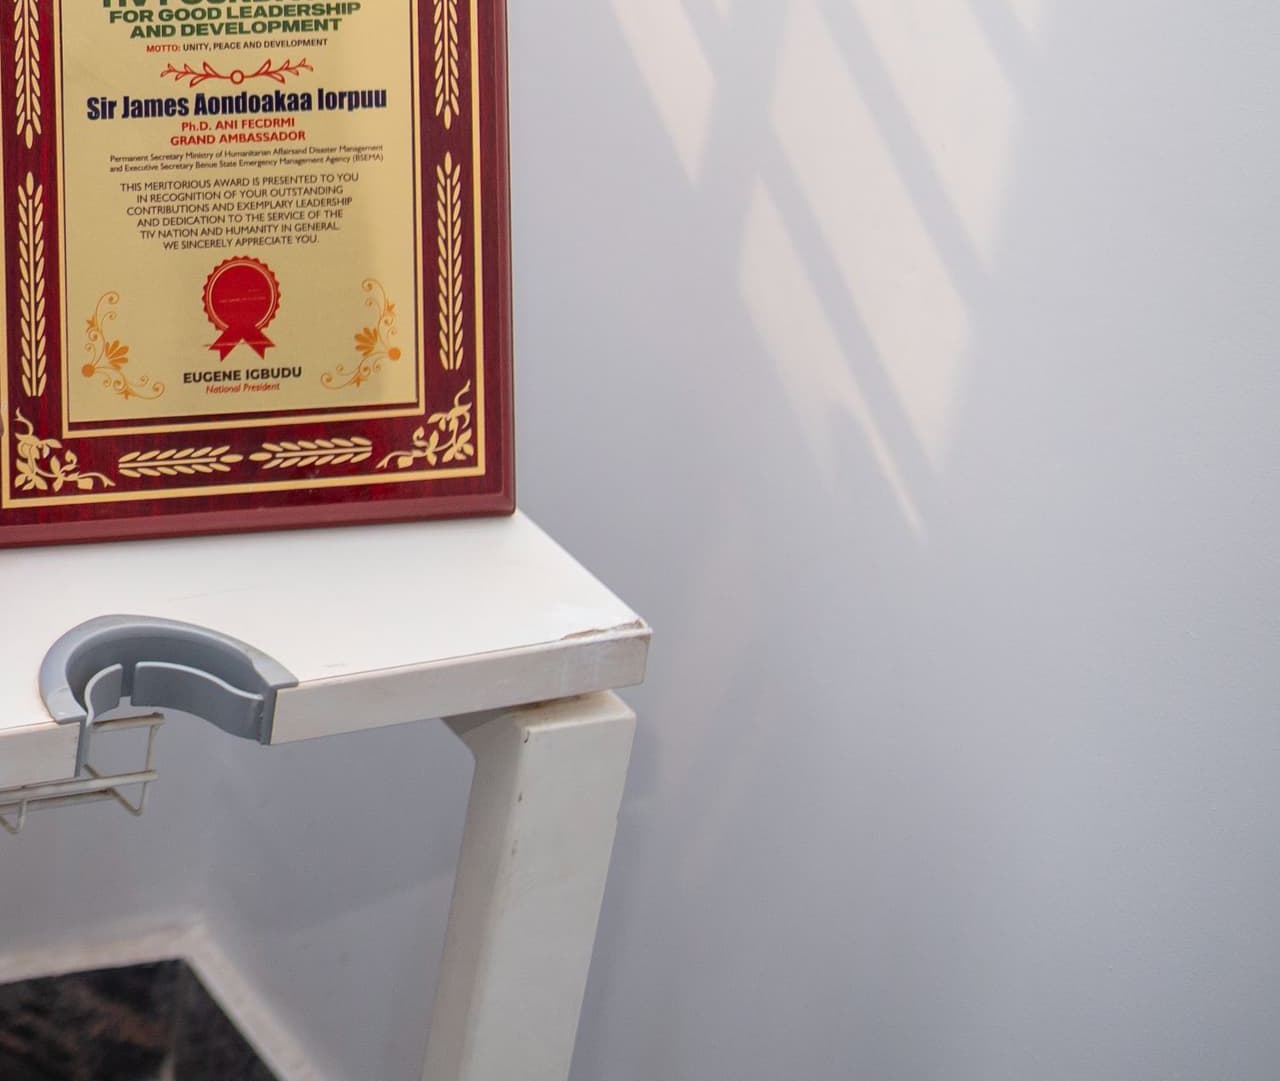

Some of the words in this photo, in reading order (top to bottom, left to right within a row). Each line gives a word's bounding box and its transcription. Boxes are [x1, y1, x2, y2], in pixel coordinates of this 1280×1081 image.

[109, 8, 153, 23] FOR
[158, 6, 222, 22] GOOD
[226, 2, 361, 20] LEADERSHIP
[130, 23, 176, 39] AND
[181, 18, 343, 37] DEVELOPMENT
[146, 44, 181, 53] MOTTO:
[182, 42, 212, 52] UNITY,
[213, 41, 241, 51] PEACE
[242, 40, 262, 49] AND
[263, 38, 328, 48] DEVELOPMENT
[87, 97, 117, 120] Sir
[121, 94, 189, 119] James
[193, 90, 313, 116] Aondoakaa
[317, 88, 387, 112] Iorpuu
[181, 121, 212, 133] Ph.D.
[214, 120, 238, 131] ANI
[241, 117, 296, 130] FECDRMI
[170, 134, 216, 147] GRAND
[218, 130, 306, 144] AMBASSADOR
[163, 240, 179, 251] WE
[181, 238, 233, 250] SINCERELY
[234, 236, 293, 248] APPRECIATE
[295, 234, 320, 245] YOU.
[183, 370, 241, 384] EUGENE
[245, 366, 302, 381] IGBUDU
[206, 383, 241, 394] National
[243, 382, 280, 393] President
